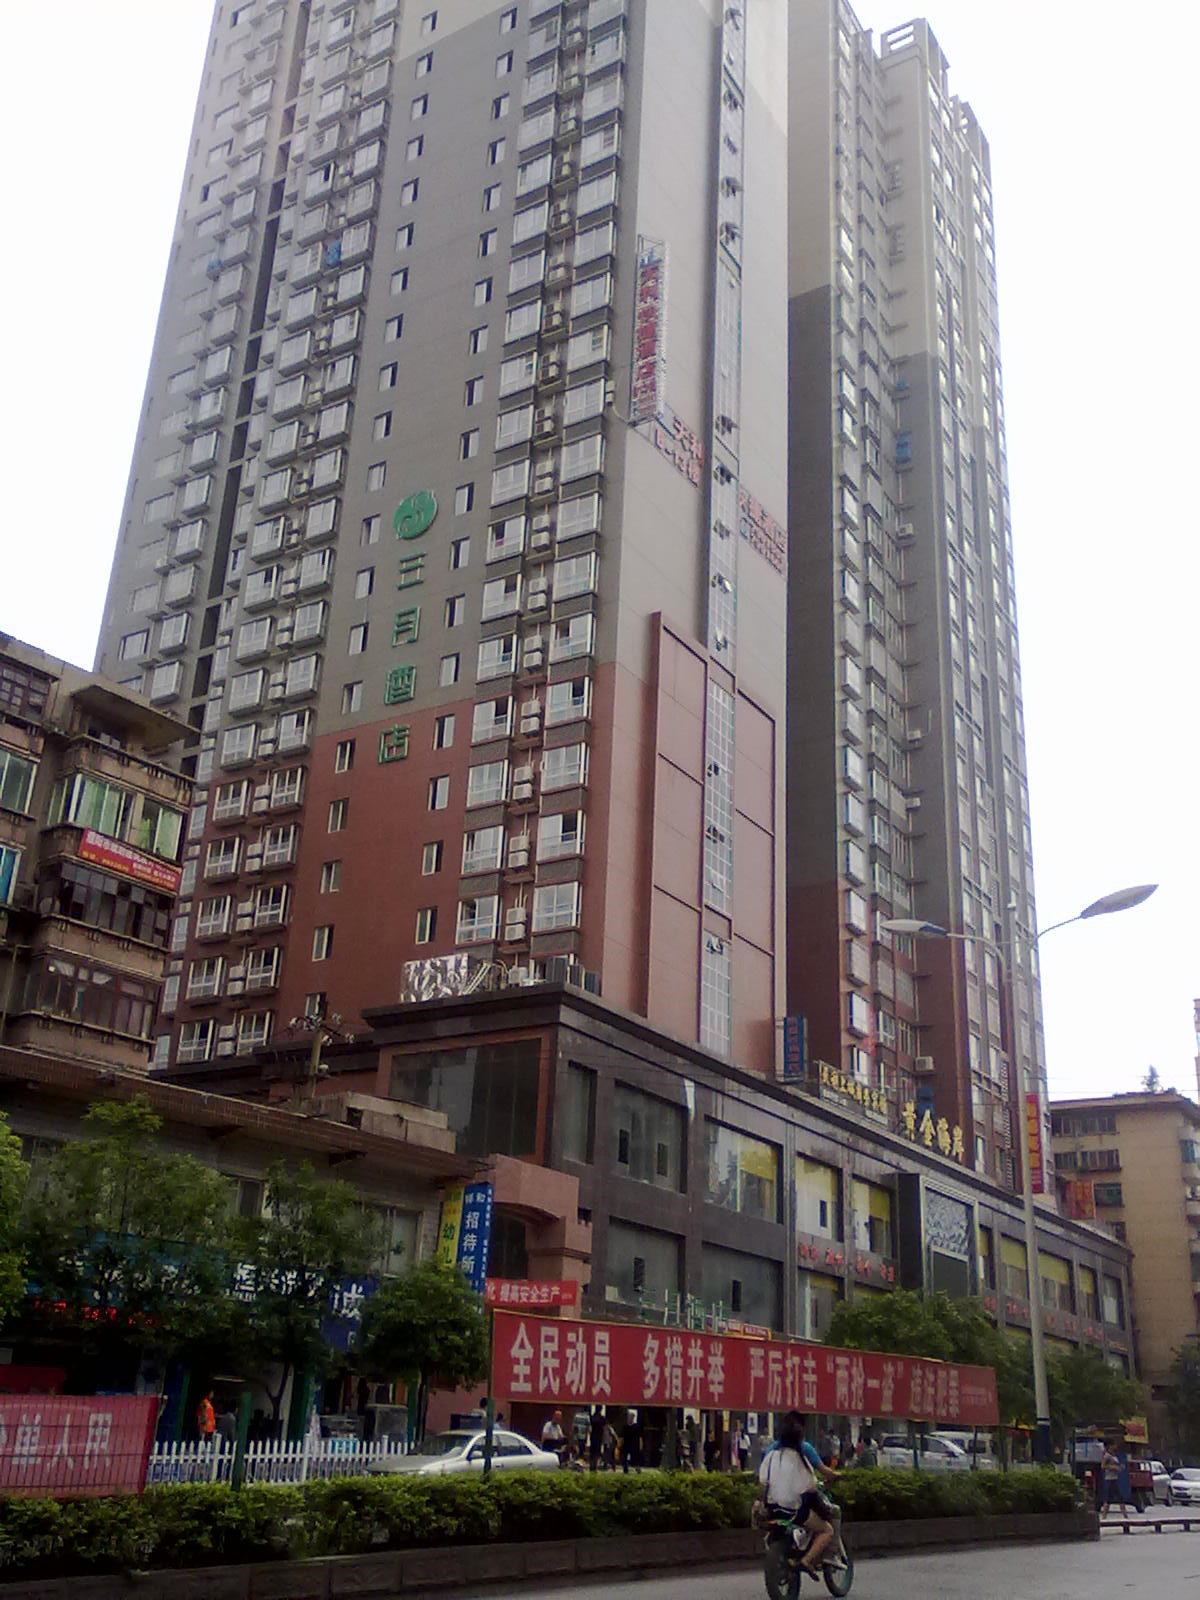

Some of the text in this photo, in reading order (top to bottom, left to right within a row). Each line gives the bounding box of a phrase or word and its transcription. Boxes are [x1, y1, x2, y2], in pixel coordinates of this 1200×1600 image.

[462, 1211, 480, 1274] 招待所
[510, 1322, 612, 1396] 全民动员
[642, 1333, 725, 1403] 多措并举
[749, 1347, 818, 1409] 严厉打击
